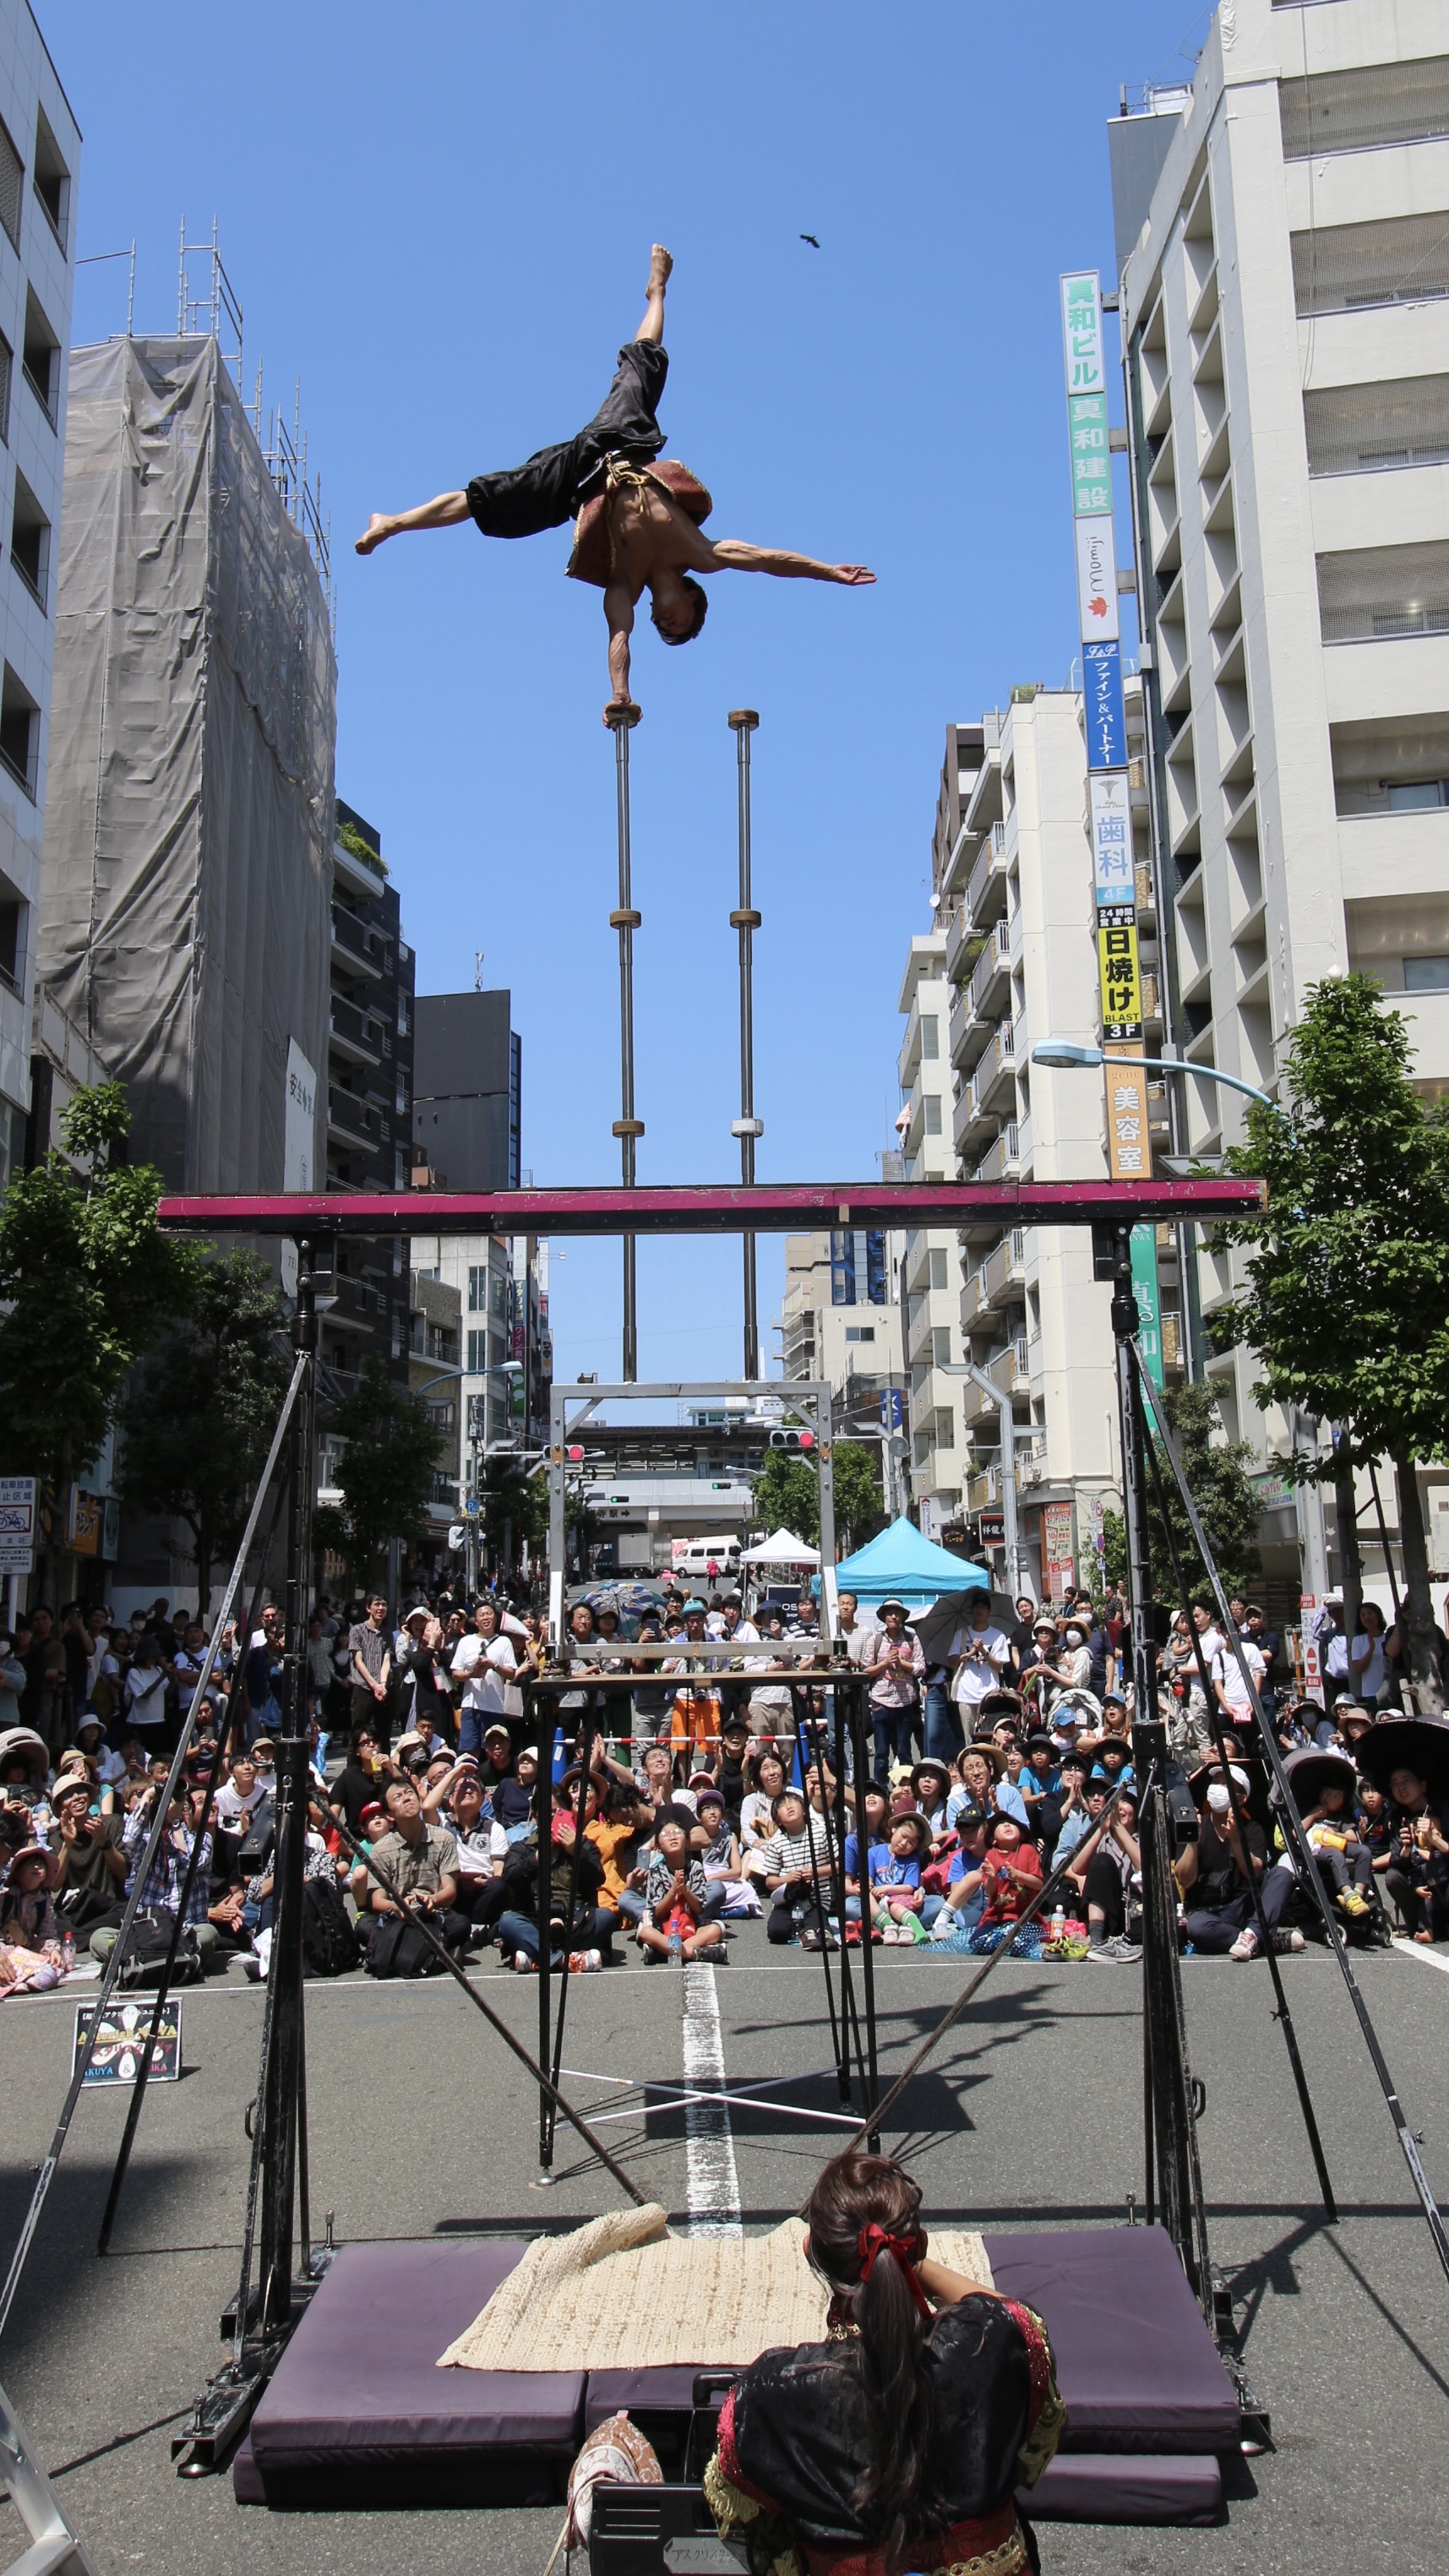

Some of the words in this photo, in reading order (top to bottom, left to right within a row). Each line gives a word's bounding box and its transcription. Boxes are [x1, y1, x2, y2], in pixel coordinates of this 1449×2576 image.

[1066, 279, 1098, 387] 真和ビル
[1072, 398, 1109, 509] 真和建設
[1086, 535, 1104, 592] momiji
[1095, 662, 1115, 764] ファイン&パートナー
[1097, 815, 1128, 878] 歯科
[1103, 887, 1126, 900] 4F
[1099, 907, 1133, 918] 24時間
[1099, 917, 1134, 927] 営業中
[1105, 929, 1134, 1011] 日焼け
[1105, 1013, 1139, 1023] BLAST
[1112, 1070, 1140, 1081] gene
[1114, 1086, 1143, 1171] 美容室
[1129, 1233, 1151, 1242] INWA
[78, 2029, 135, 2042] Aterisk
[138, 2025, 177, 2039] NVA
